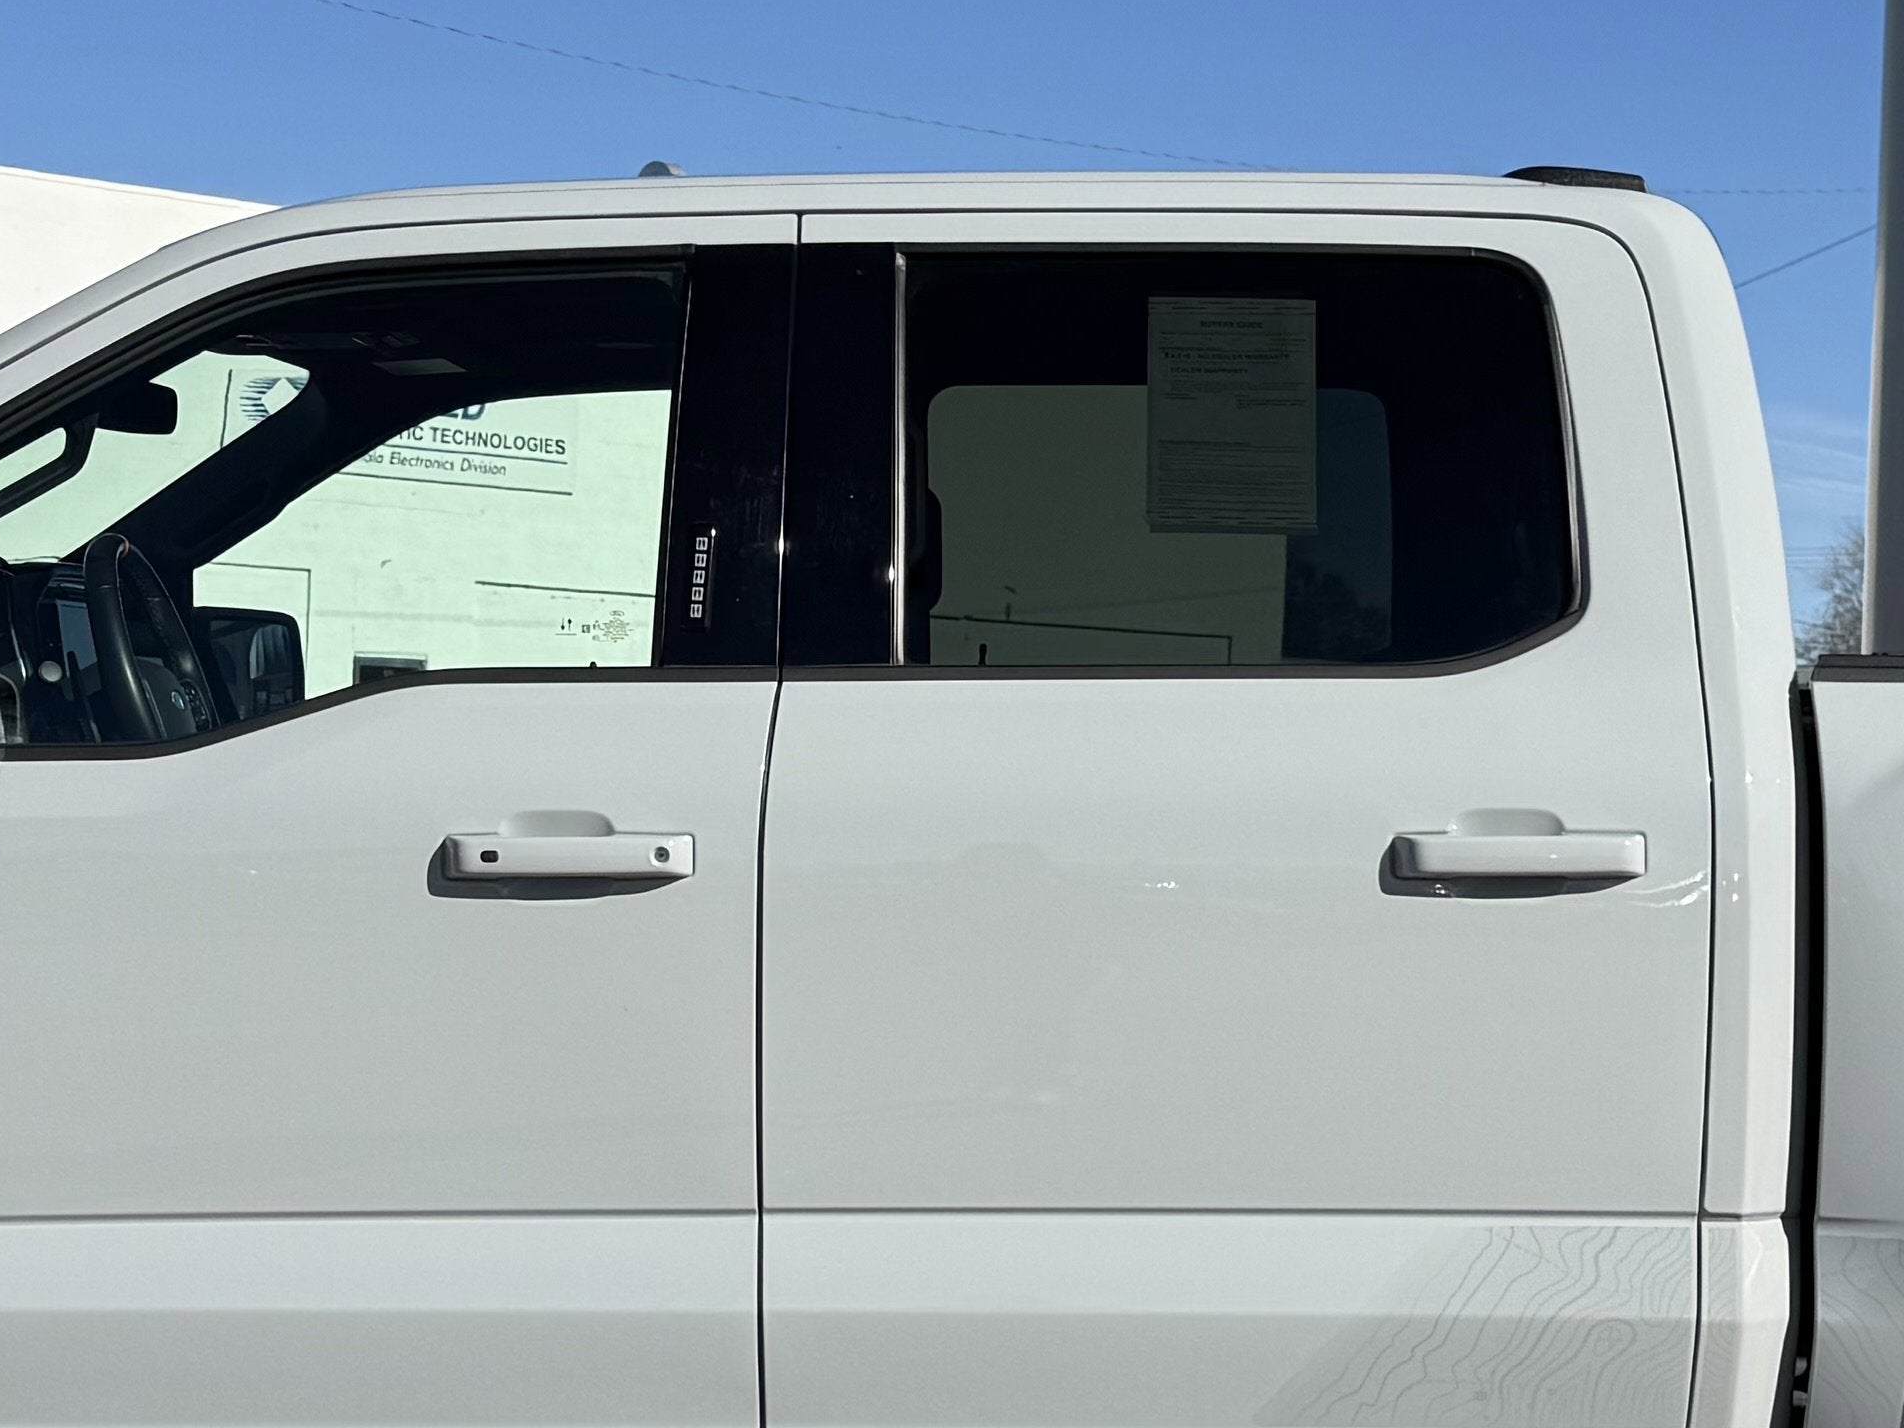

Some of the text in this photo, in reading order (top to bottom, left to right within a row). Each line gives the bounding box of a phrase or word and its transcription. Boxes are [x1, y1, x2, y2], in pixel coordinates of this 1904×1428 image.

[429, 426, 567, 456] TECHNOLOGIES
[390, 451, 455, 472] Electronics
[461, 457, 507, 476] Division
